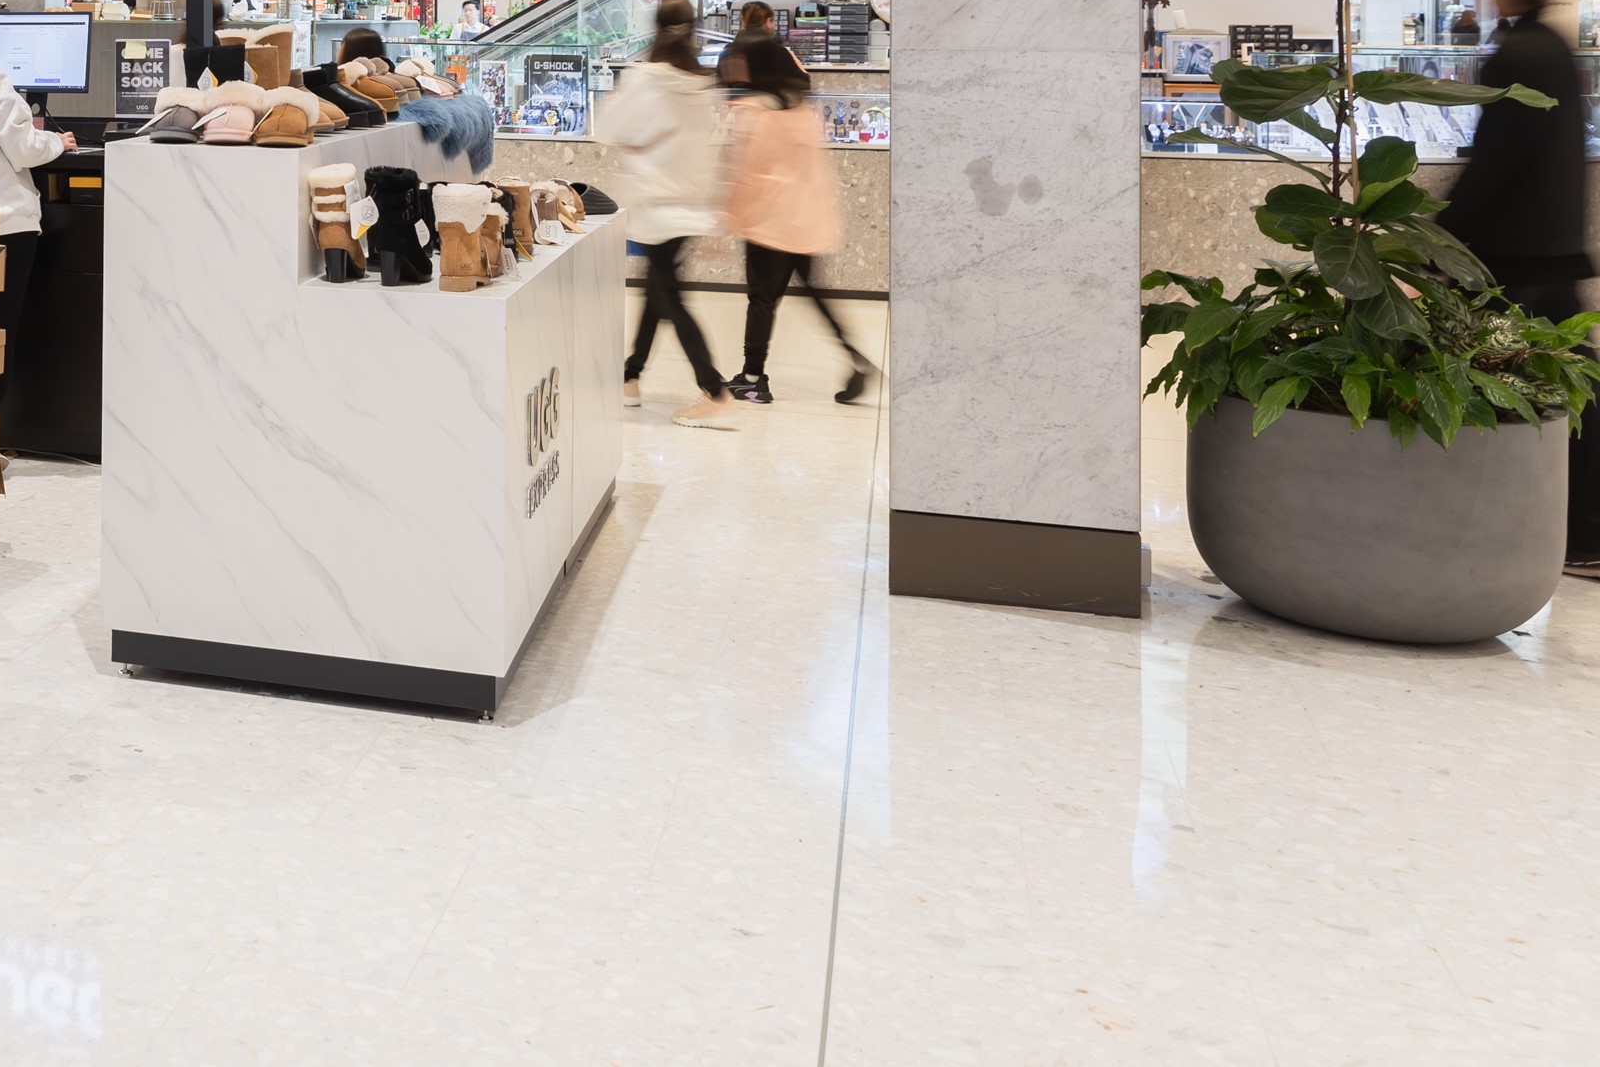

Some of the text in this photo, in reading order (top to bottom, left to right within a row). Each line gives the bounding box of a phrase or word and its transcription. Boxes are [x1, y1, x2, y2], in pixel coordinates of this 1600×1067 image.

[121, 47, 164, 59] ME
[1176, 45, 1186, 72] Active
[121, 62, 164, 73] BACK
[533, 61, 575, 71] G-SHOCK
[121, 76, 164, 88] SOON
[527, 366, 561, 467] UGG
[527, 449, 560, 520] EXPRESS
